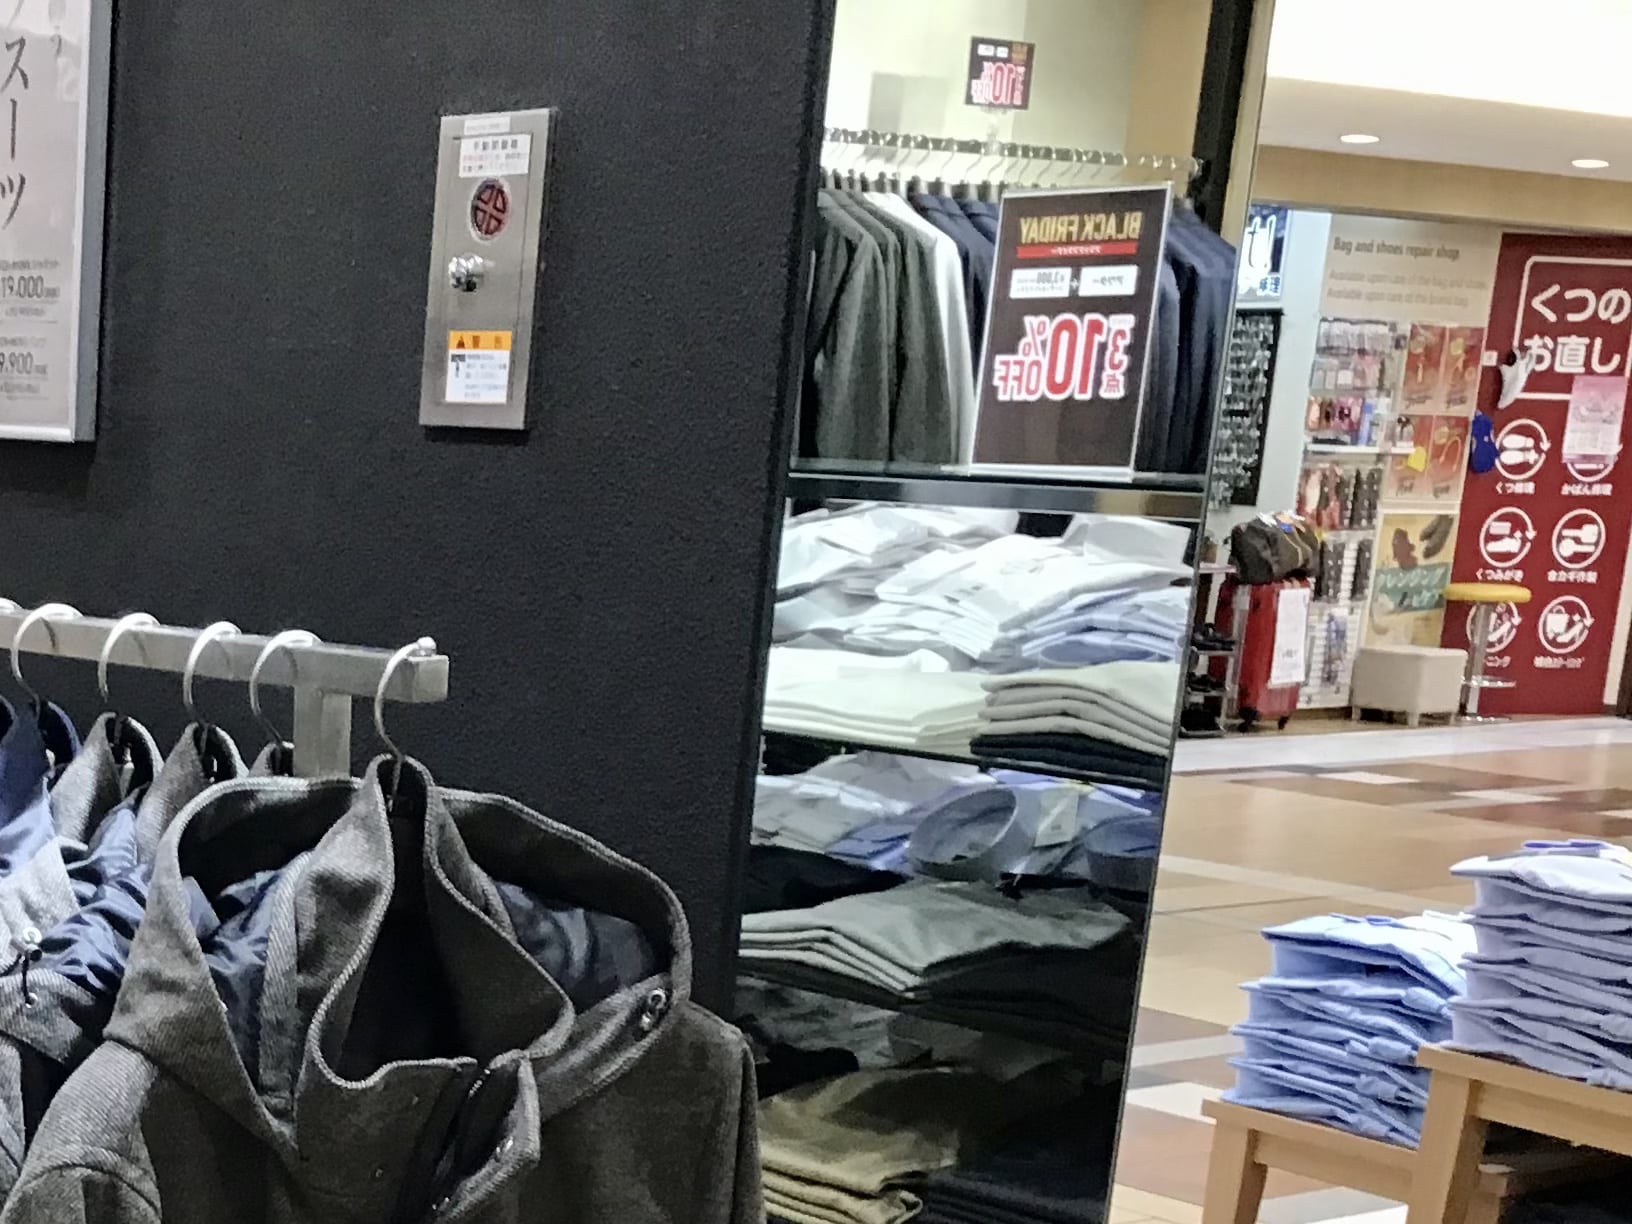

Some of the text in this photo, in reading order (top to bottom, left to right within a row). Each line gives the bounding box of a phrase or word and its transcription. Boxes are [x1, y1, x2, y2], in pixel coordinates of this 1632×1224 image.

[1333, 236, 1460, 262] Bag and shoes repair shop
[1531, 284, 1632, 324] くつの
[1524, 334, 1621, 374] お直し
